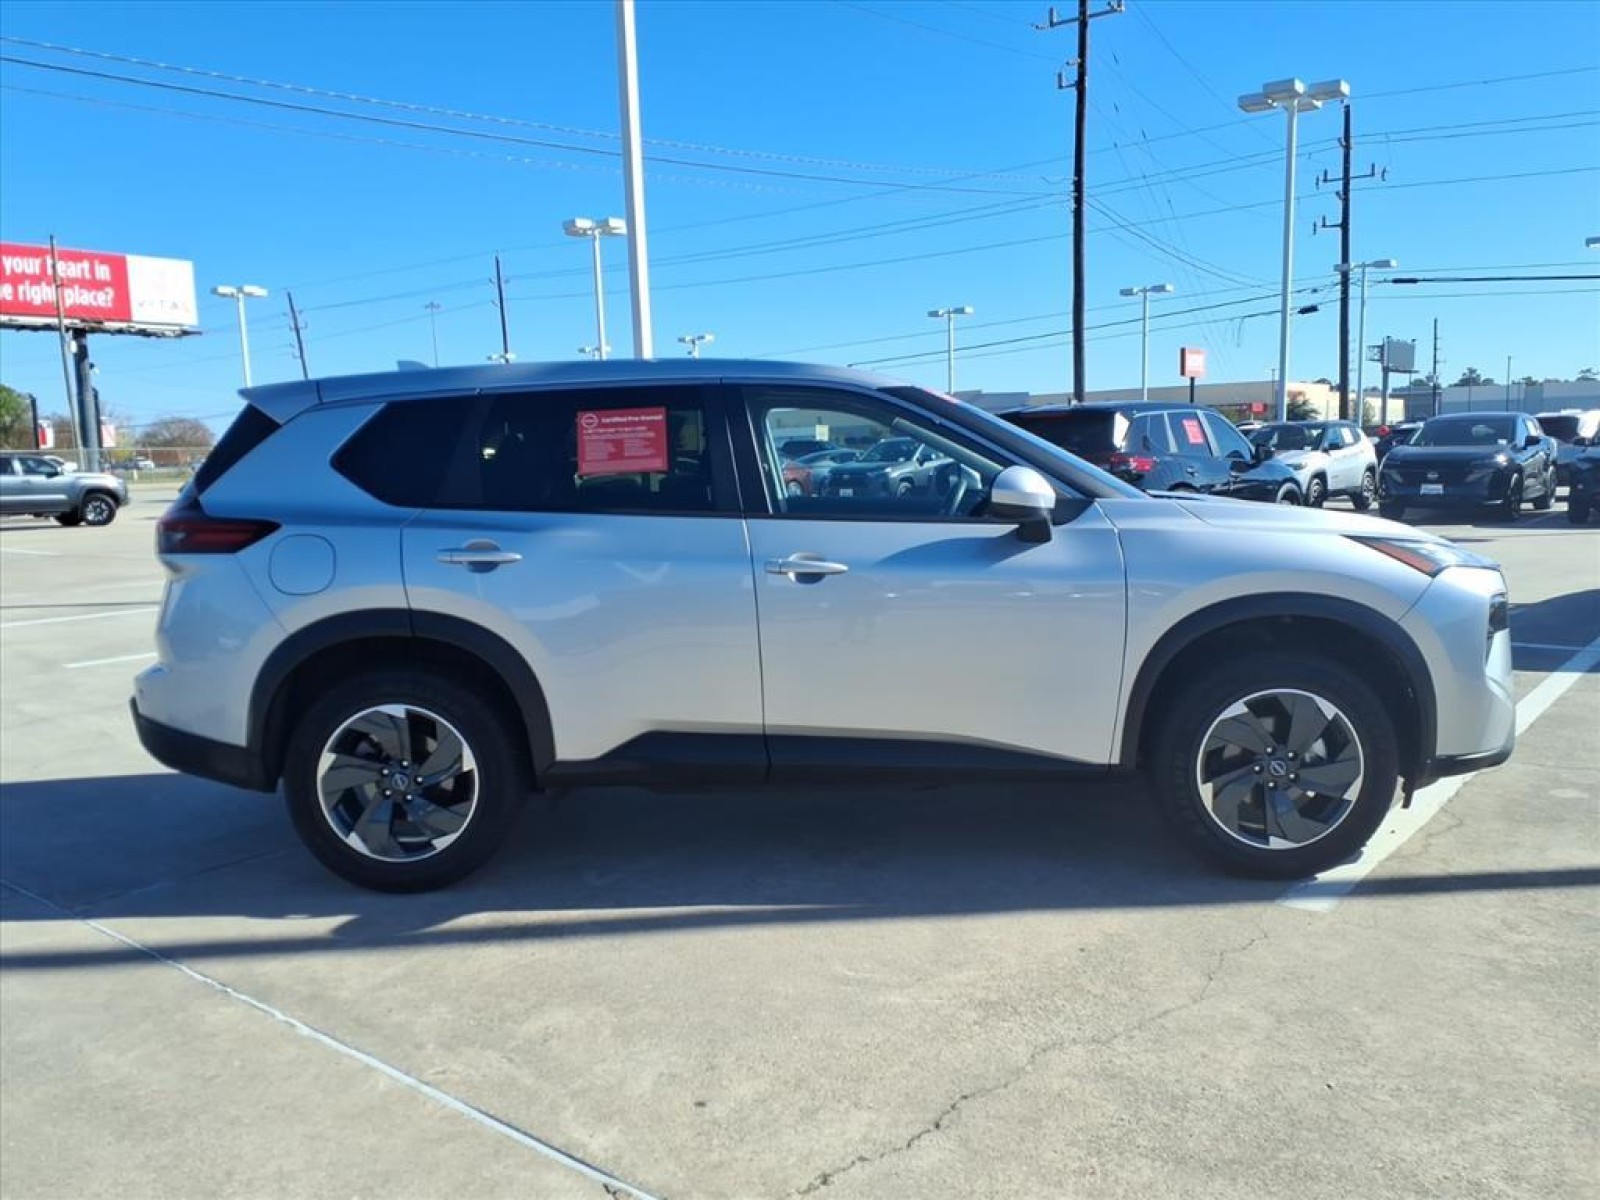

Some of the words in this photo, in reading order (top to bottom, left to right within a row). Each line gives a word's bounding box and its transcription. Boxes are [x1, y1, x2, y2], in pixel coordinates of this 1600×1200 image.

[2, 256, 41, 275] your
[94, 259, 111, 281] in
[64, 285, 114, 308] place?
